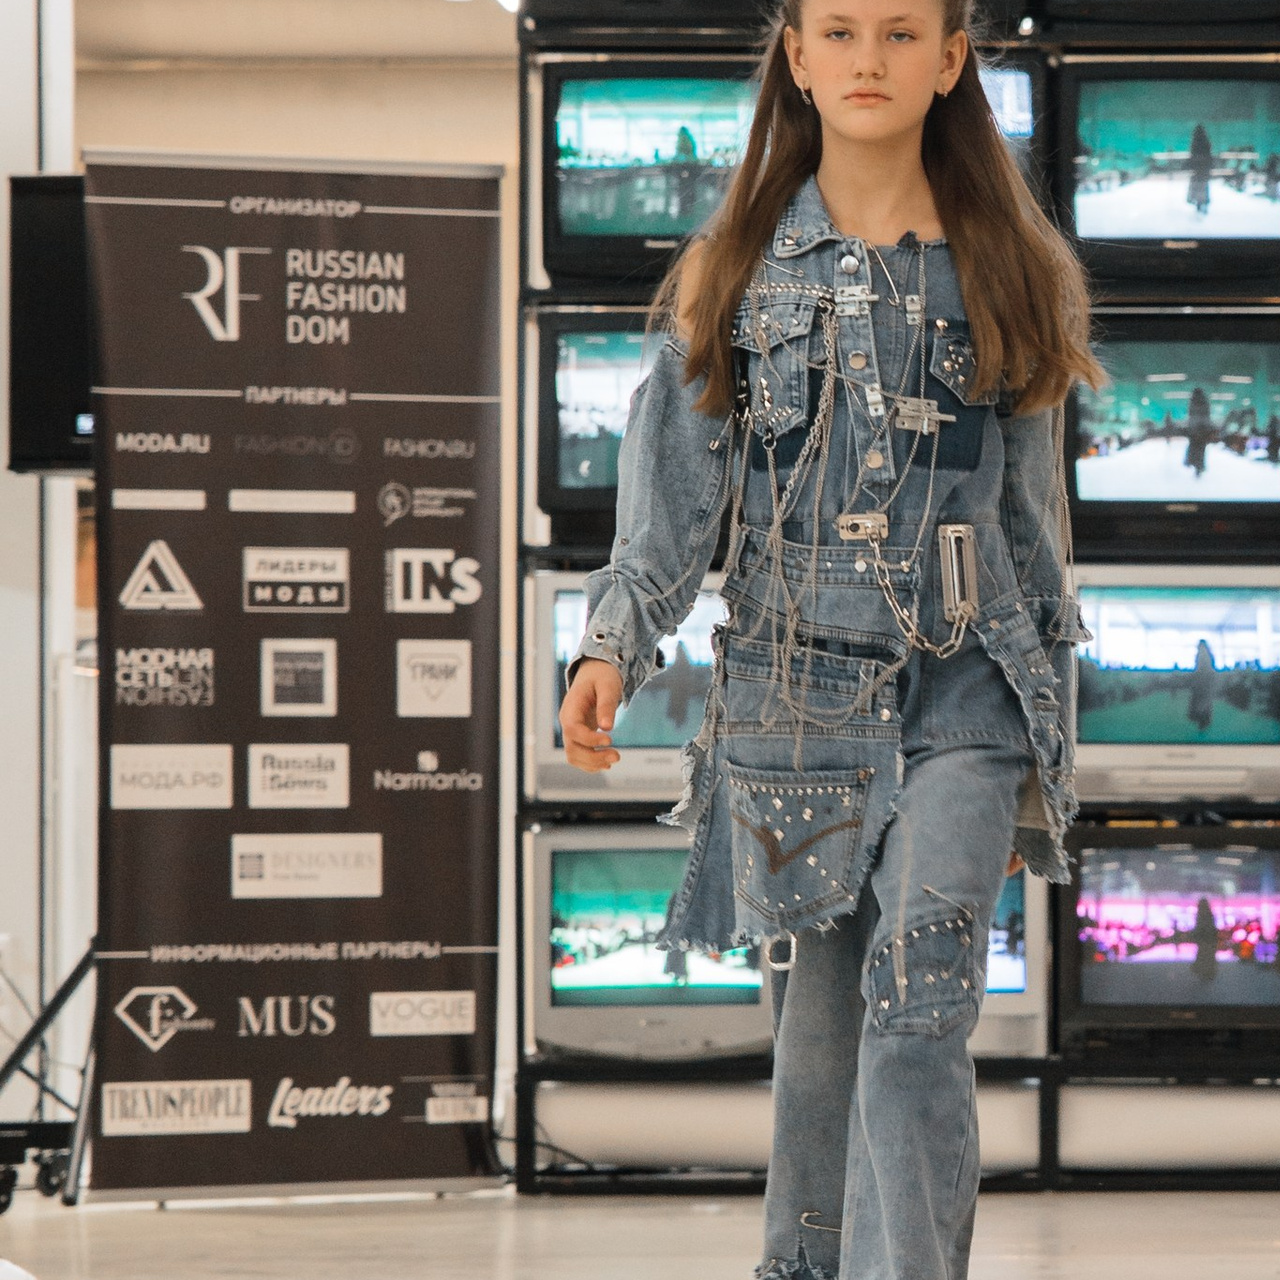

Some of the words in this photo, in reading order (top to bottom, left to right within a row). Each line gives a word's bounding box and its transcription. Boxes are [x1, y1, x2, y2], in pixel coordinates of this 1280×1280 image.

[230, 196, 362, 218] ОРГАНИЗАТОР
[286, 249, 405, 281] RUSSIAN
[286, 282, 406, 313] FASHION
[286, 316, 350, 345] DOM
[245, 385, 347, 405] ПАРТНЕРЫ
[115, 432, 211, 454] MODA.RU
[255, 558, 338, 576] ЛИДЕРЫ
[254, 585, 340, 605] МОДЫ
[115, 648, 214, 668] МОДНАЯ
[115, 667, 173, 687] СЕТЬ
[119, 770, 225, 790] МОДА.РФ
[151, 942, 338, 964] ИНФОРМАЦИОННЫЕ
[342, 940, 441, 960] ПАРТНЕРЫ
[237, 995, 336, 1038] MUS
[373, 996, 470, 1021] VOGUE
[267, 1076, 393, 1128] Leaders
